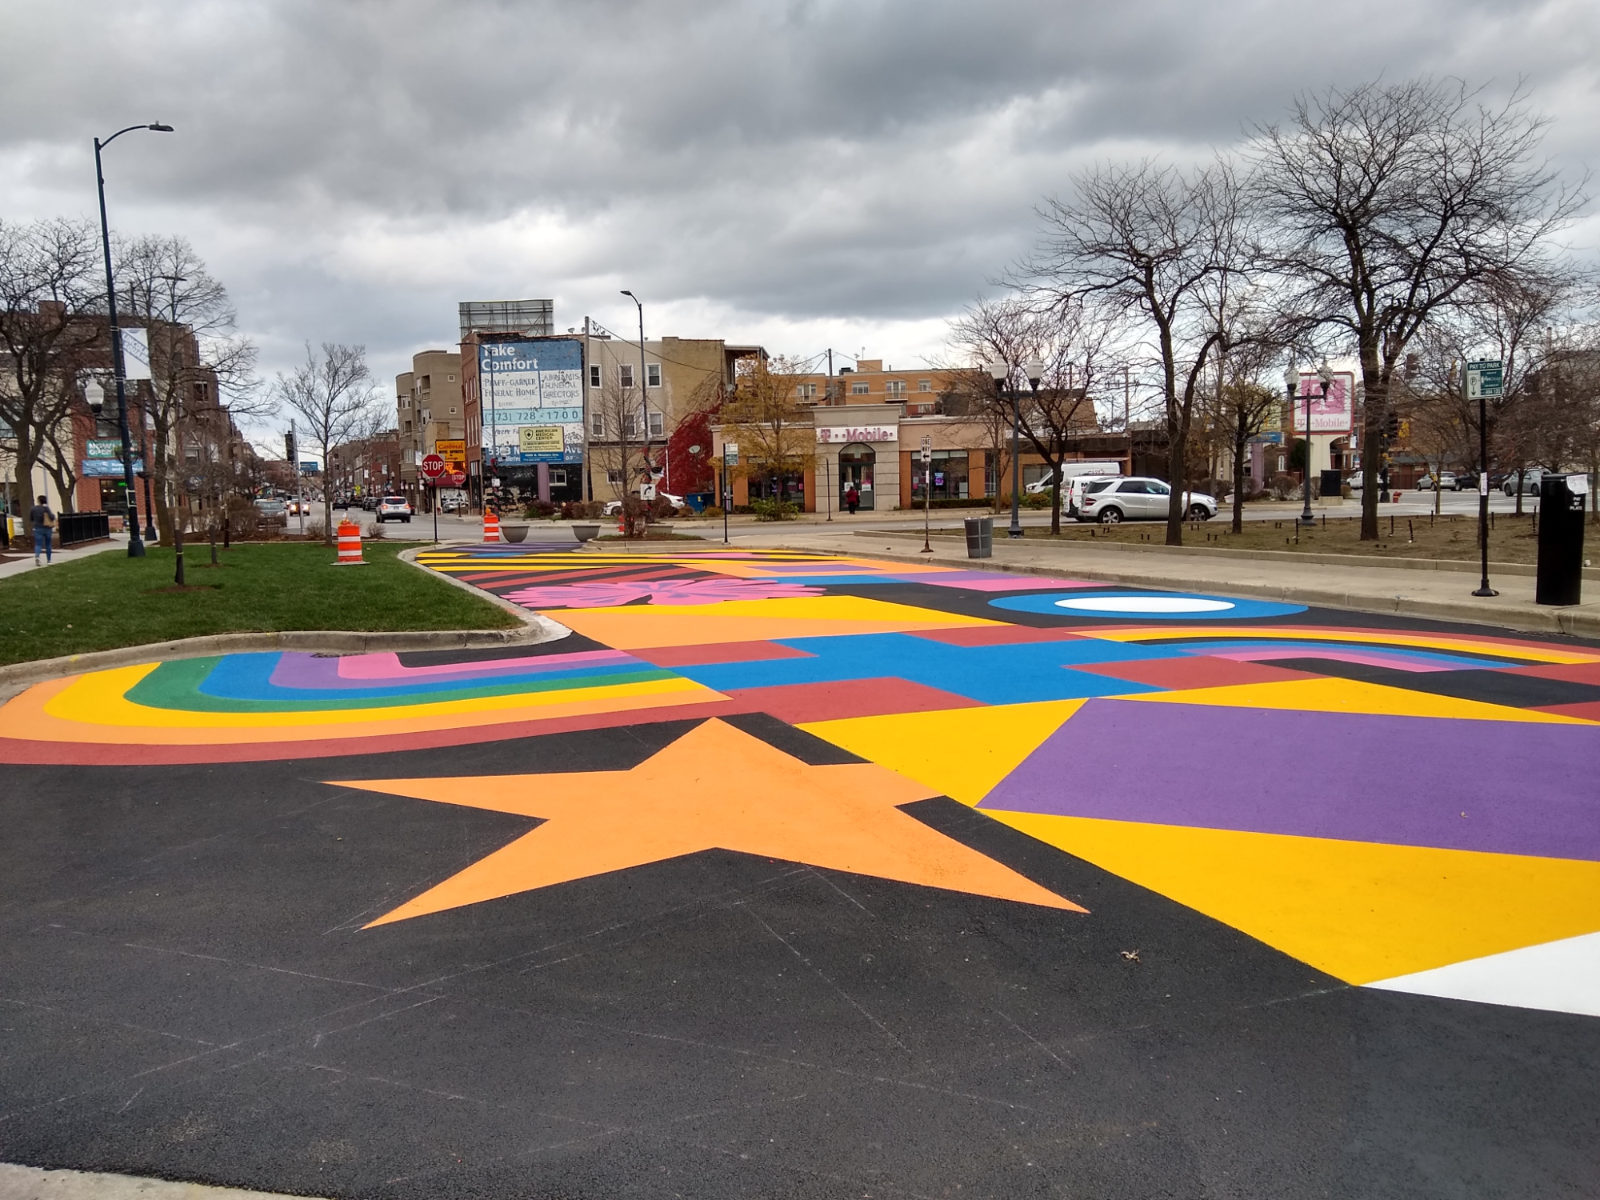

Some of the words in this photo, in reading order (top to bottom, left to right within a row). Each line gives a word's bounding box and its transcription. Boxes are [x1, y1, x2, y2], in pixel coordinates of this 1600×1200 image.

[481, 344, 515, 357] Take
[481, 358, 538, 371] Comfort
[515, 388, 536, 397] HOME
[423, 461, 444, 471] STOP
